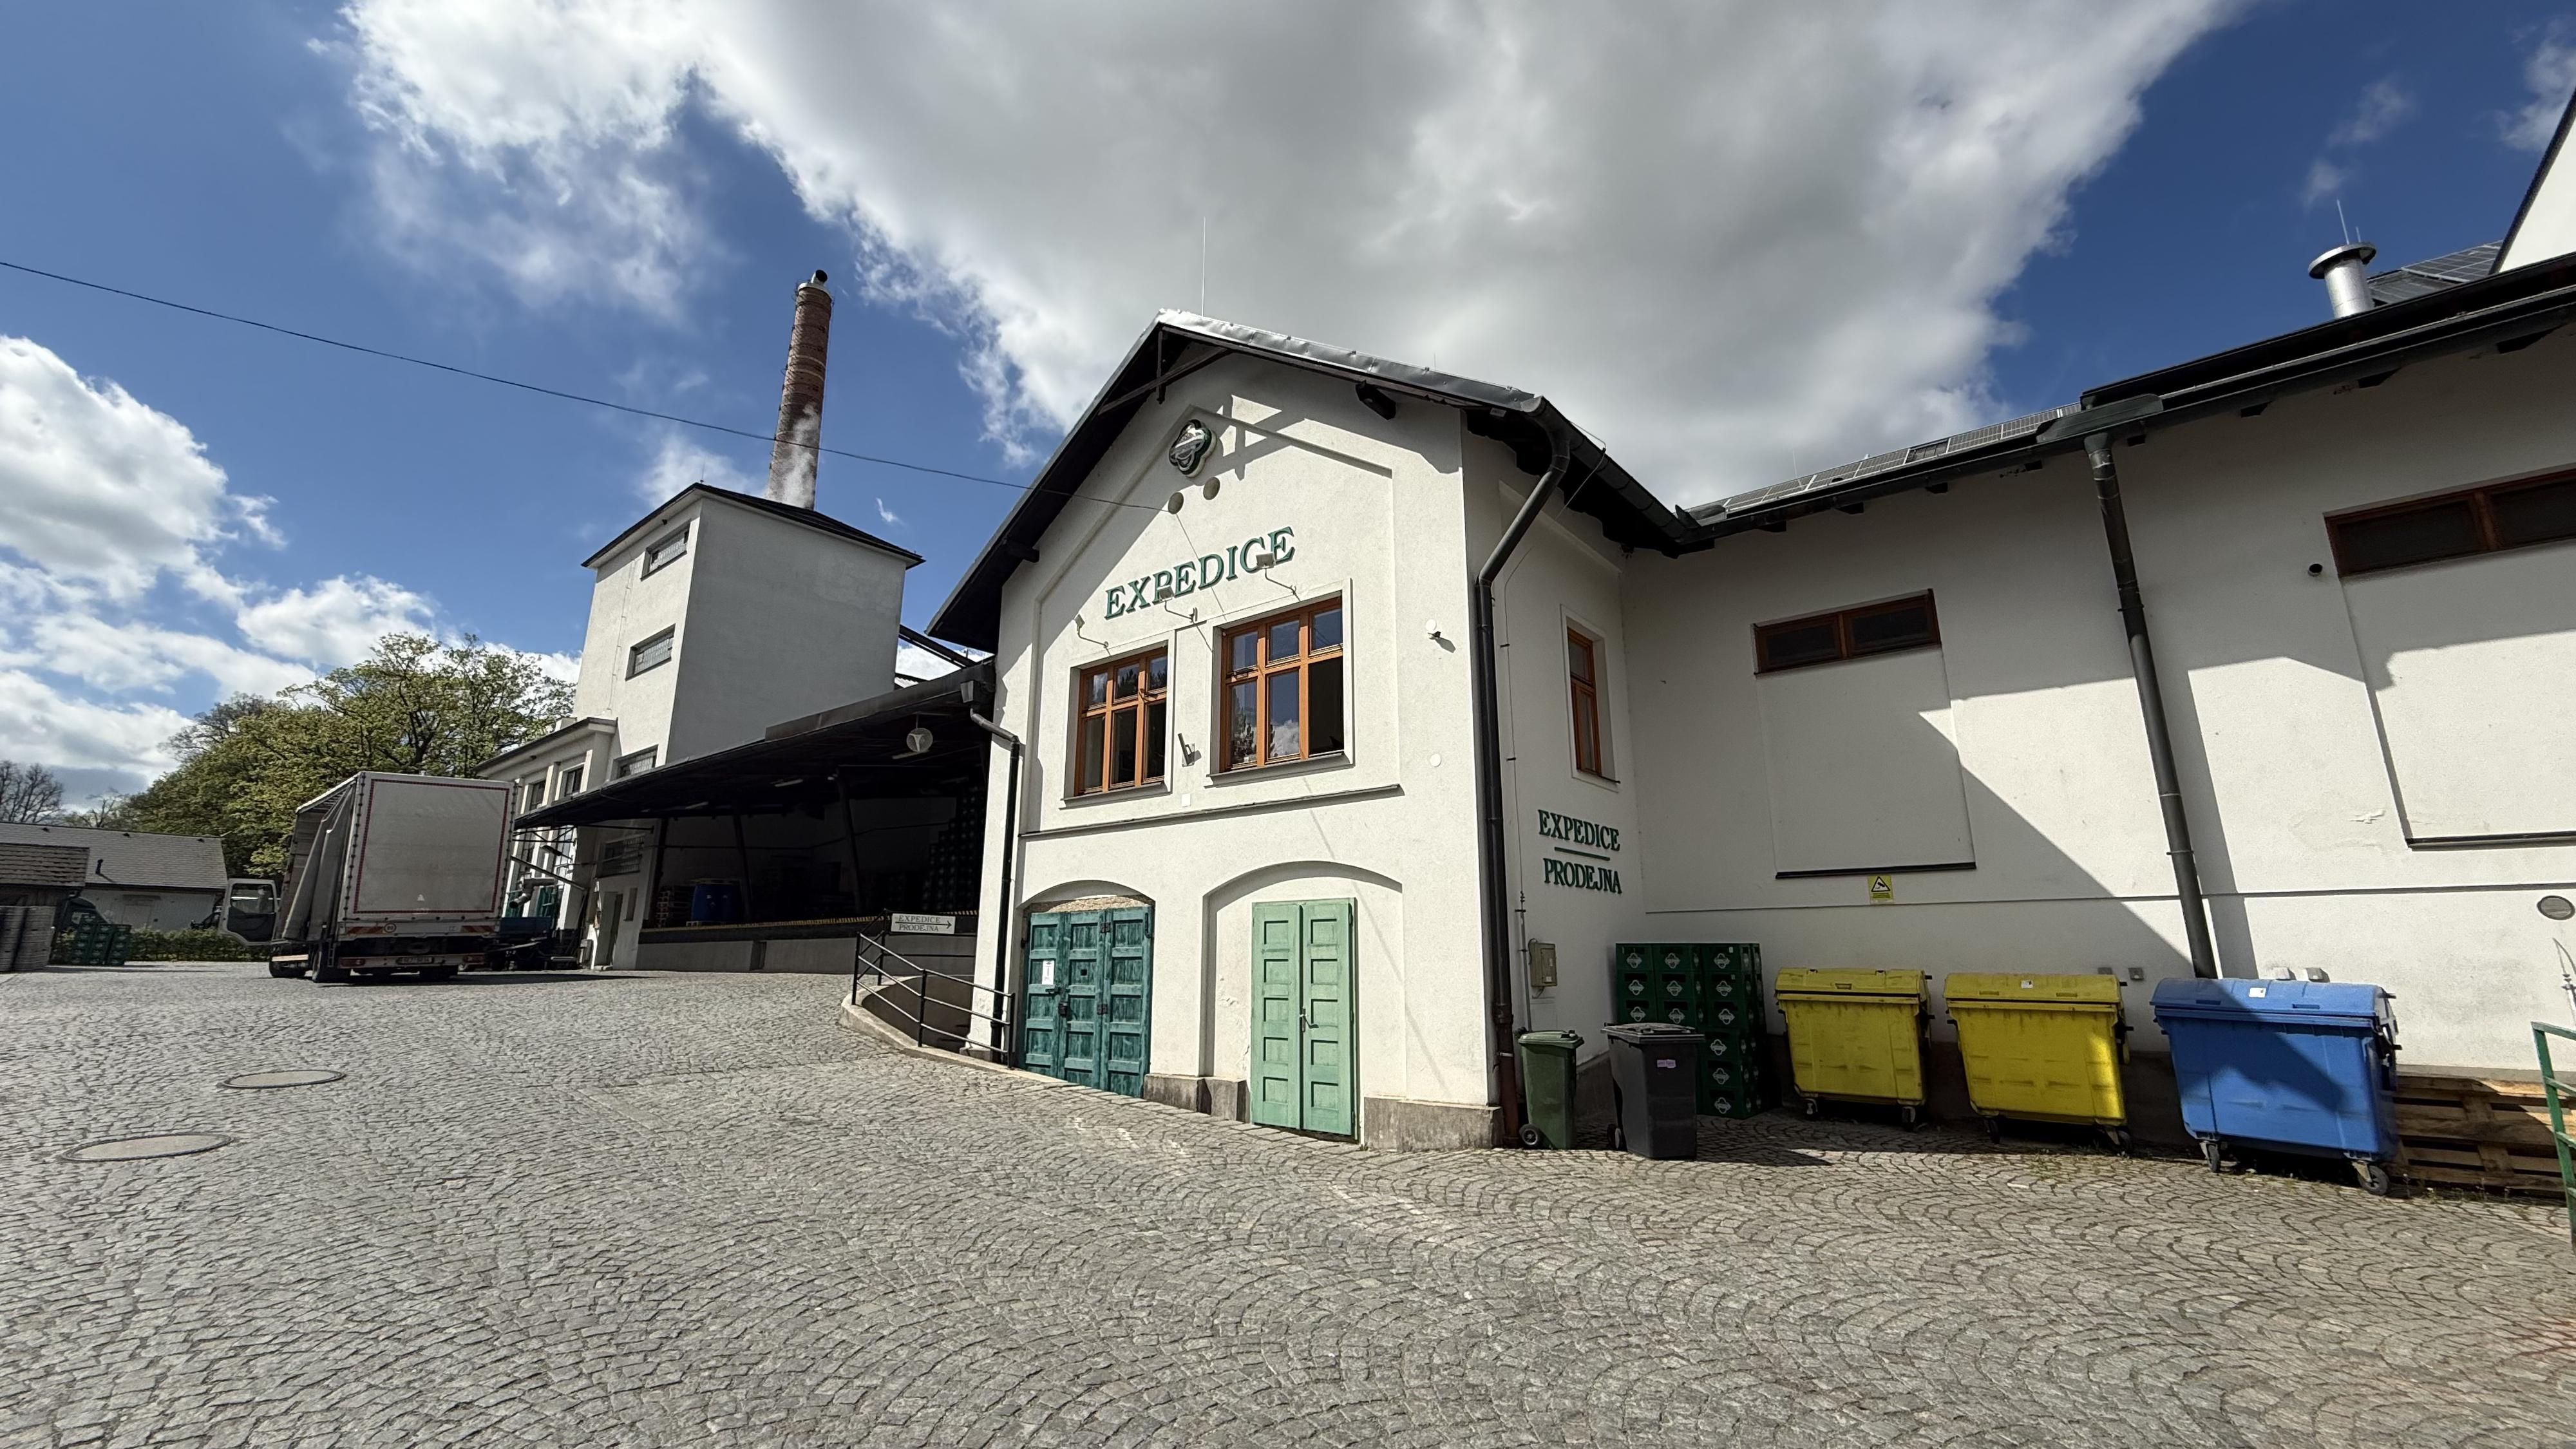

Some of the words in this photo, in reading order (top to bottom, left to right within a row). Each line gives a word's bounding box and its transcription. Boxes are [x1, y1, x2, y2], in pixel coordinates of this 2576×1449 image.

[1104, 526, 1296, 621] EXPEDICE
[1538, 809, 1620, 851] EXPEDICE
[1543, 858, 1622, 895] PRODEJNA
